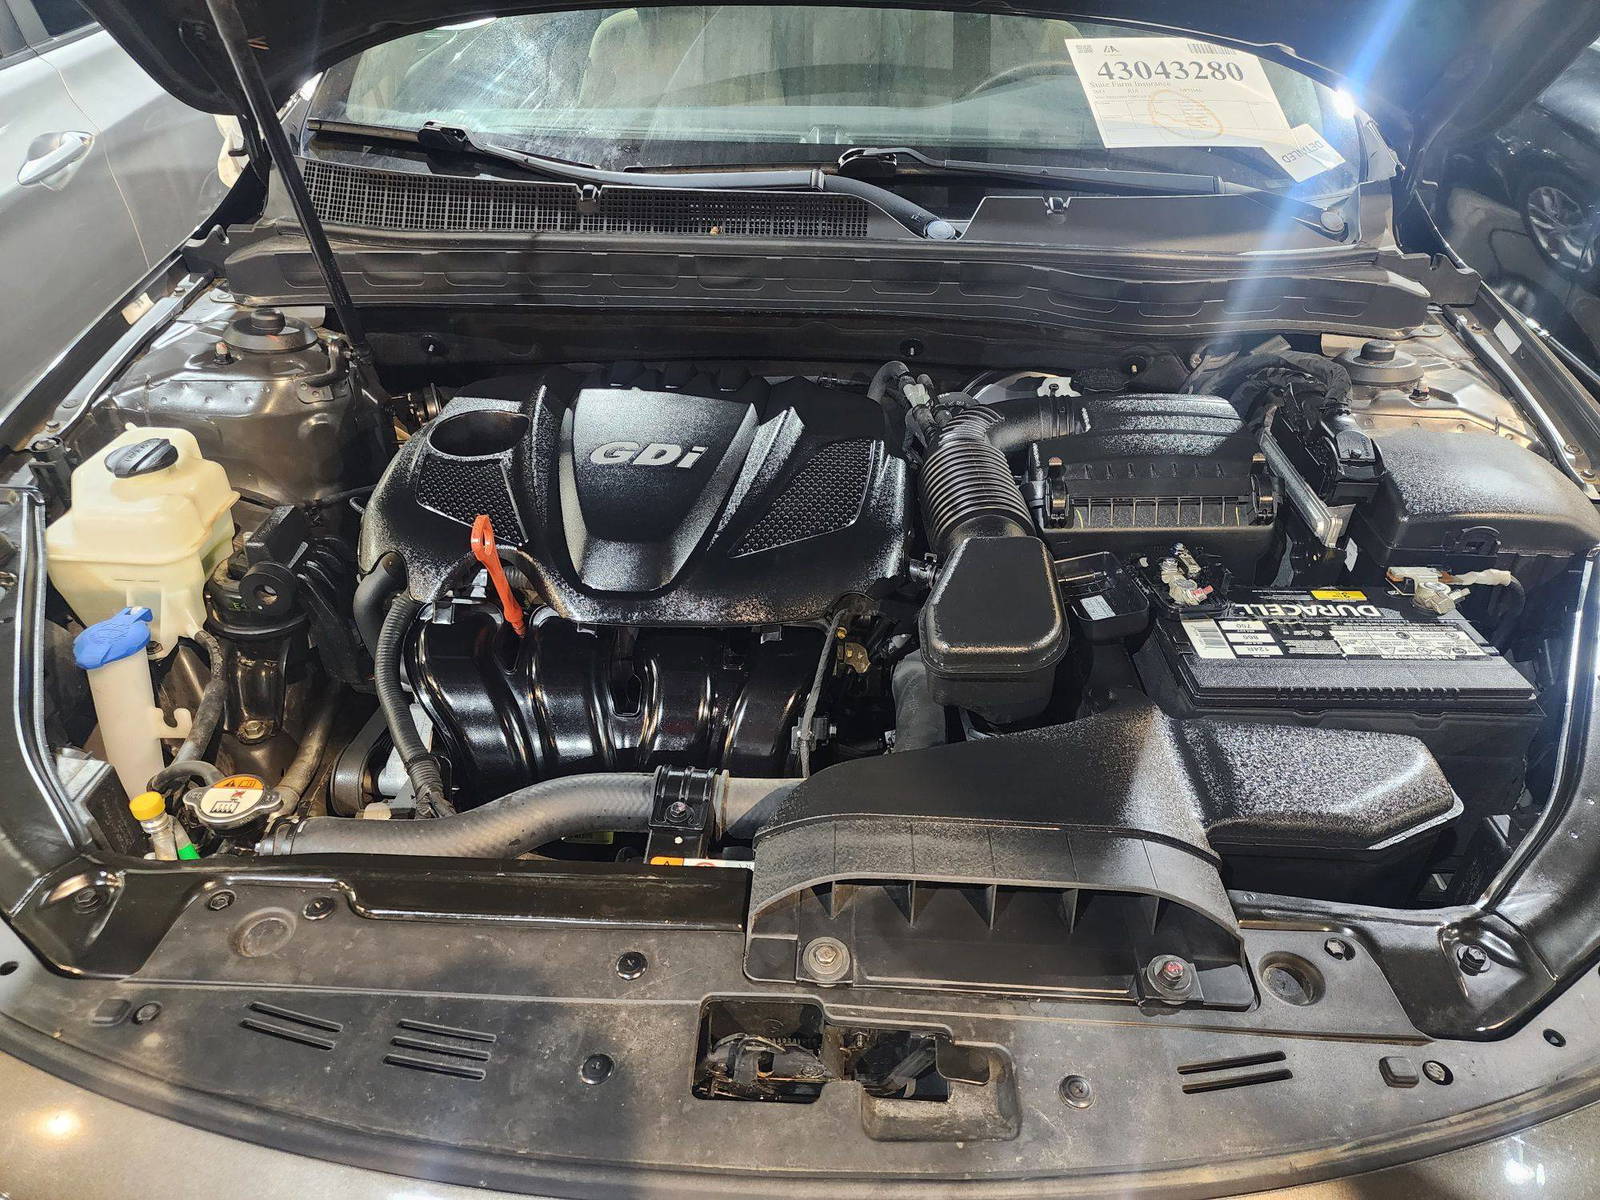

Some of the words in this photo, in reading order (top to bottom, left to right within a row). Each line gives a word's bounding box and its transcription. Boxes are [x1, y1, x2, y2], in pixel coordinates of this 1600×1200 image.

[1097, 60, 1244, 82] 43043280
[1281, 140, 1324, 163] DETAILED
[589, 441, 709, 469] GDi
[1234, 603, 1382, 617] DURACELL
